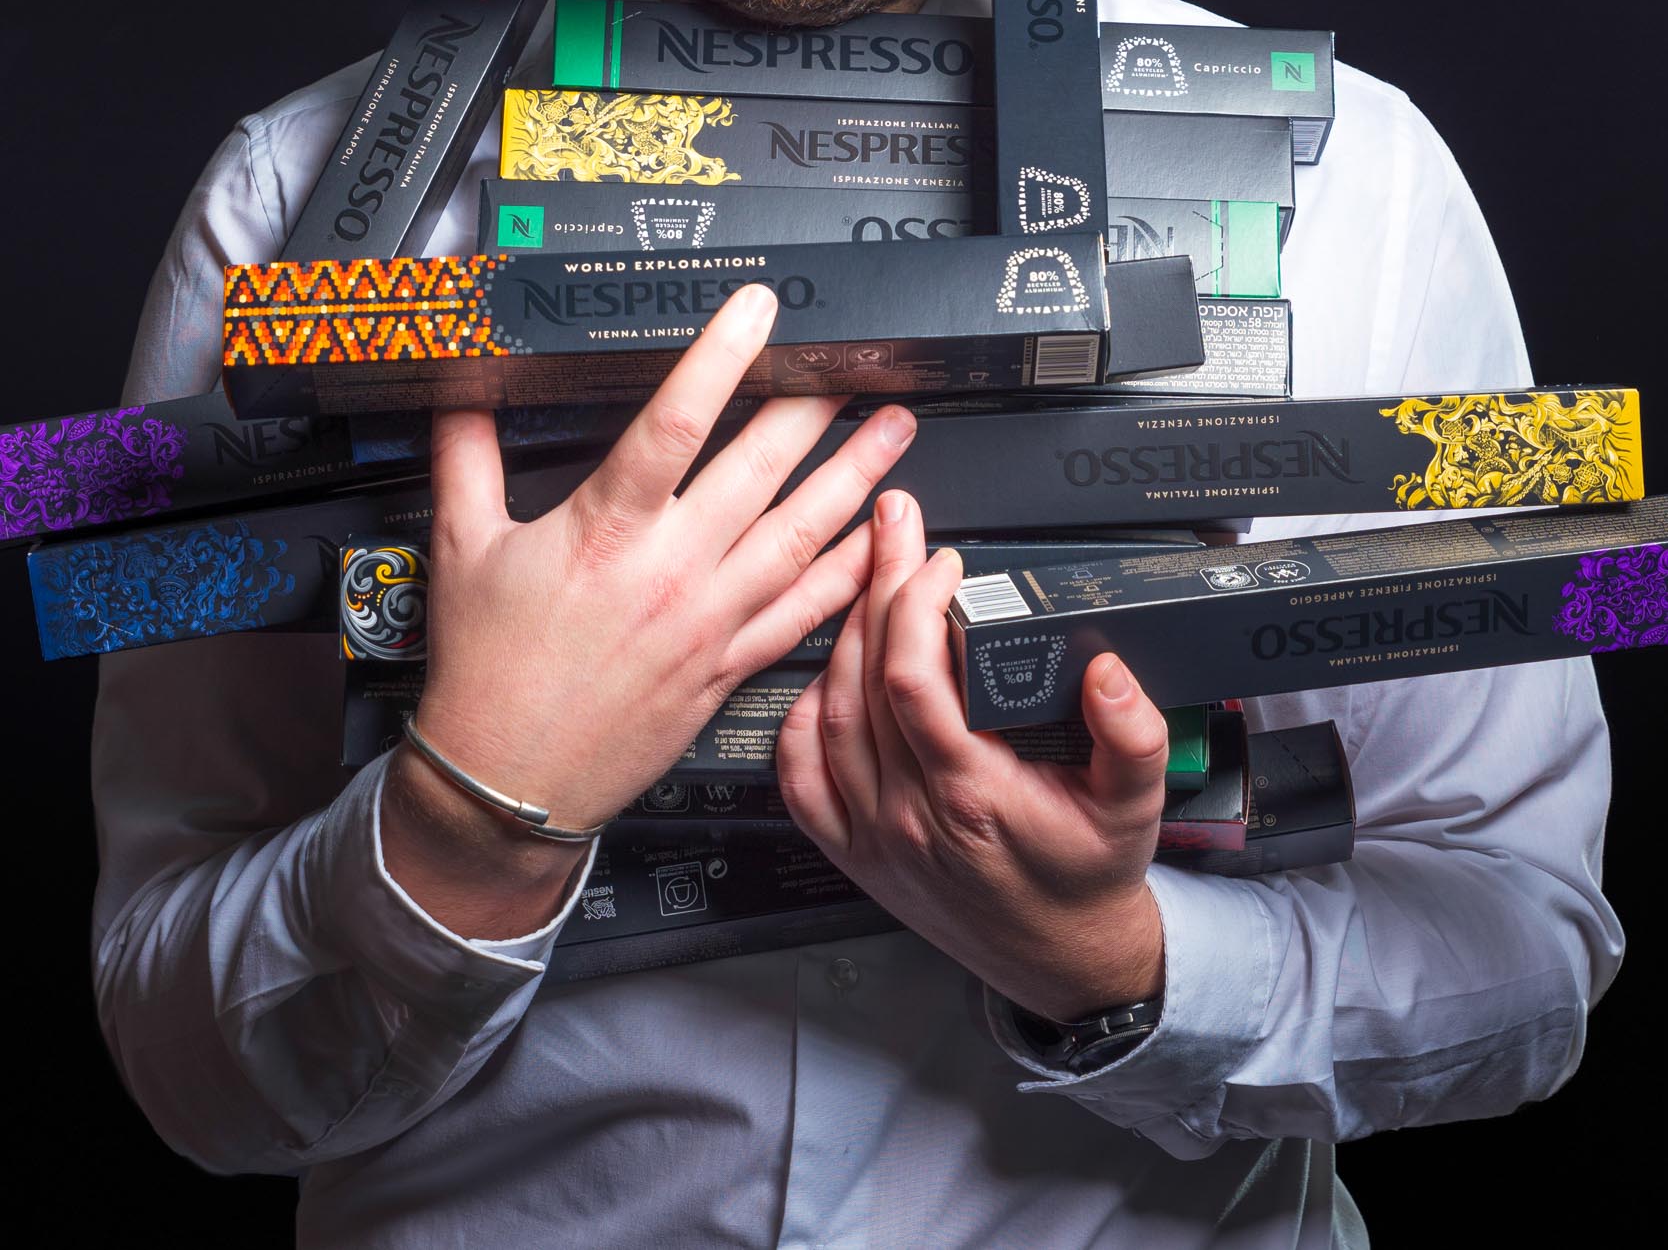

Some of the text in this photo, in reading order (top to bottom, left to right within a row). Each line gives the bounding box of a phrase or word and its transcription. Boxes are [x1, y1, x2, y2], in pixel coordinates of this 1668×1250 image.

[640, 17, 973, 76] NESPRESSO
[1135, 56, 1163, 68] 80%
[1193, 61, 1261, 77] Capriccio
[337, 57, 399, 167] ISPIRAZIONE NAPOLI
[333, 13, 482, 243] NESPRESSO
[837, 118, 960, 130] ISPIRAZIONE ITALIANA
[398, 82, 460, 190] ISPIRAZIONE ITALIANA
[757, 121, 970, 173] NESPRES
[833, 175, 964, 187] ISPIRAZIONE VENEZIA
[1052, 191, 1064, 213] 80%
[553, 220, 623, 234] Capriccio
[656, 228, 682, 239] 80%
[565, 255, 767, 273] WORLD EXPLORATIONS
[1029, 270, 1058, 281] 80%
[1253, 306, 1283, 320] קפה
[1247, 318, 1262, 328] 58
[589, 329, 638, 339] VIENNA
[644, 326, 694, 337] LINIZIO
[1136, 414, 1279, 429] ISPIRAZIONE VENEZIA
[1062, 429, 1363, 491] NESPRESSO
[252, 462, 333, 484] ISPIRAZIONE
[1144, 485, 1278, 500] ISPIRAZIONE ITALIANA
[383, 508, 434, 523] ISPIRAZI
[1288, 572, 1497, 606] ISPIRAZIONE FIRENZE ARPEGGIO
[1248, 586, 1535, 661] NESPRESSO
[806, 637, 832, 646] LUN
[1328, 643, 1459, 667] ISPIRAZIONE ITALIANA
[1003, 671, 1032, 684] 80%
